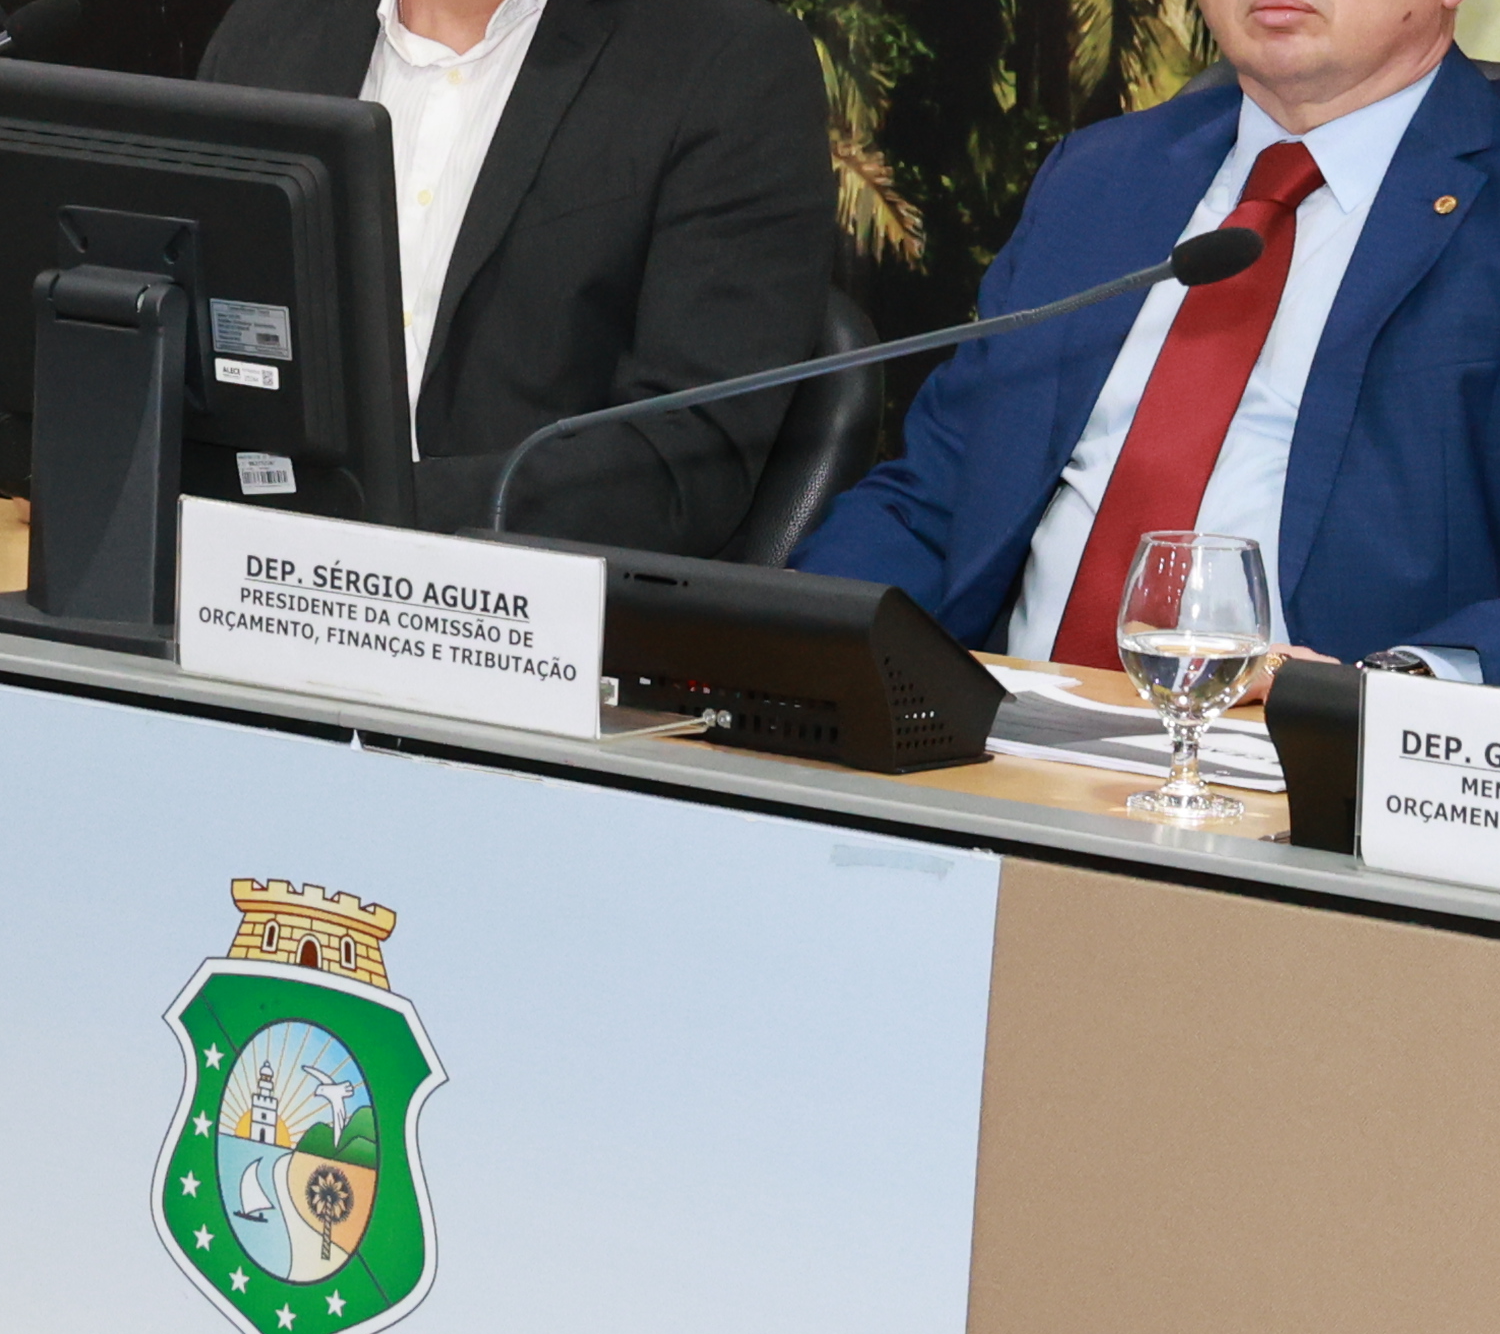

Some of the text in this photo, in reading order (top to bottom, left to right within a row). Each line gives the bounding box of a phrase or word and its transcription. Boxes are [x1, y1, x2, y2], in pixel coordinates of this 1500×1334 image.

[241, 587, 533, 648] PRESIDENTE DA COMISSÃO DE
[247, 555, 528, 618] DEP. SÉRGIO AGUIAR
[199, 607, 576, 681] ORÇAMENTO, FINANÇAS E TRIBUTAÇÃO
[1403, 730, 1470, 763] DEP.
